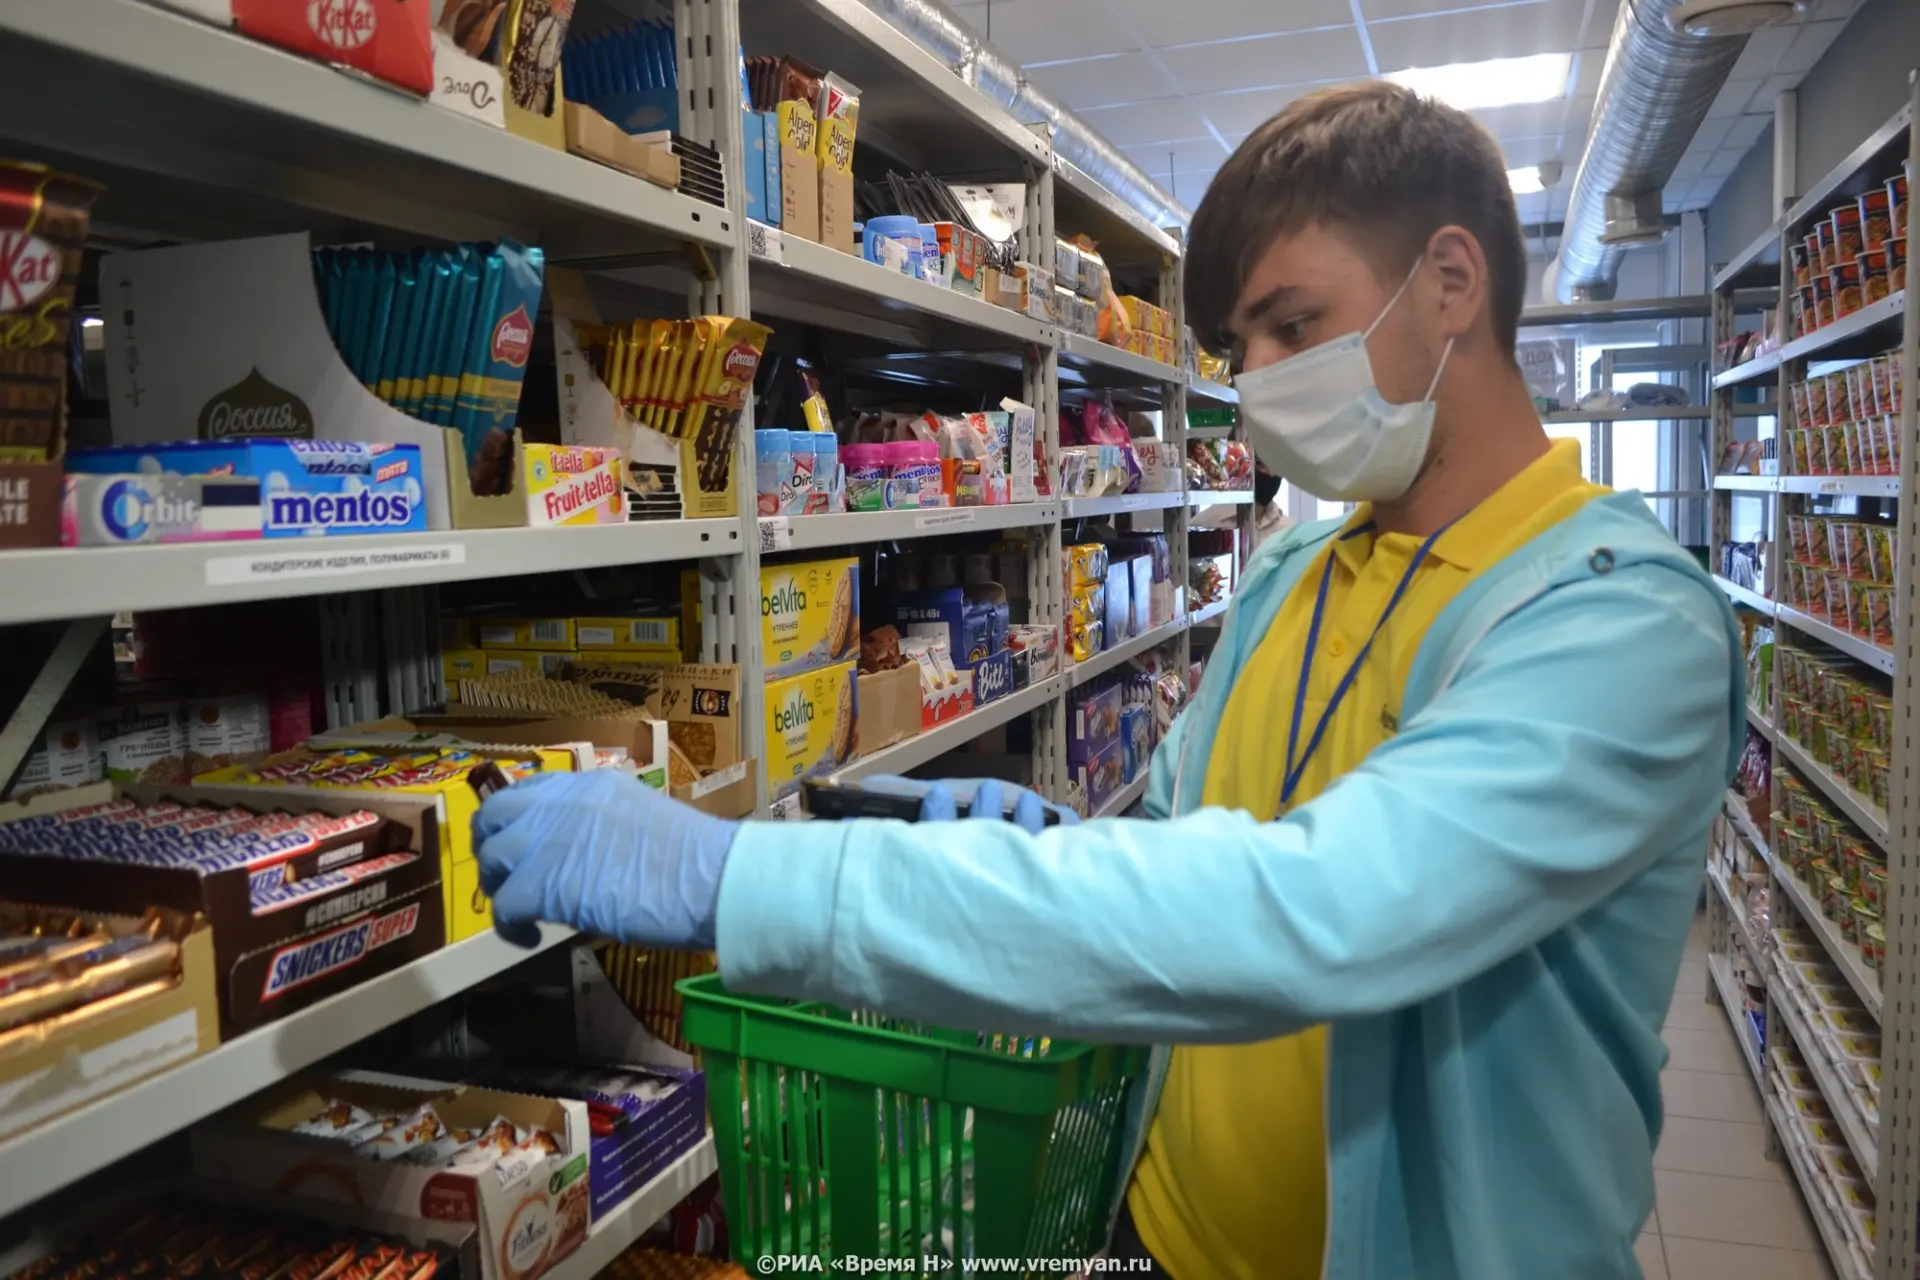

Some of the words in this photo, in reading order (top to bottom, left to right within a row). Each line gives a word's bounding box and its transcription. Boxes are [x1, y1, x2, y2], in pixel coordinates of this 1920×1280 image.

[442, 76, 496, 109] Dove
[788, 107, 814, 136] Alpen
[831, 124, 852, 148] Alpen
[208, 401, 306, 439] Россия
[101, 479, 200, 541] Orbit
[271, 487, 410, 526] mentos
[545, 473, 615, 520] Fruit-tella
[761, 576, 807, 617] belVita
[774, 689, 815, 734] belVita
[269, 923, 369, 991] SNICKERS
[371, 907, 419, 946] SUPER
